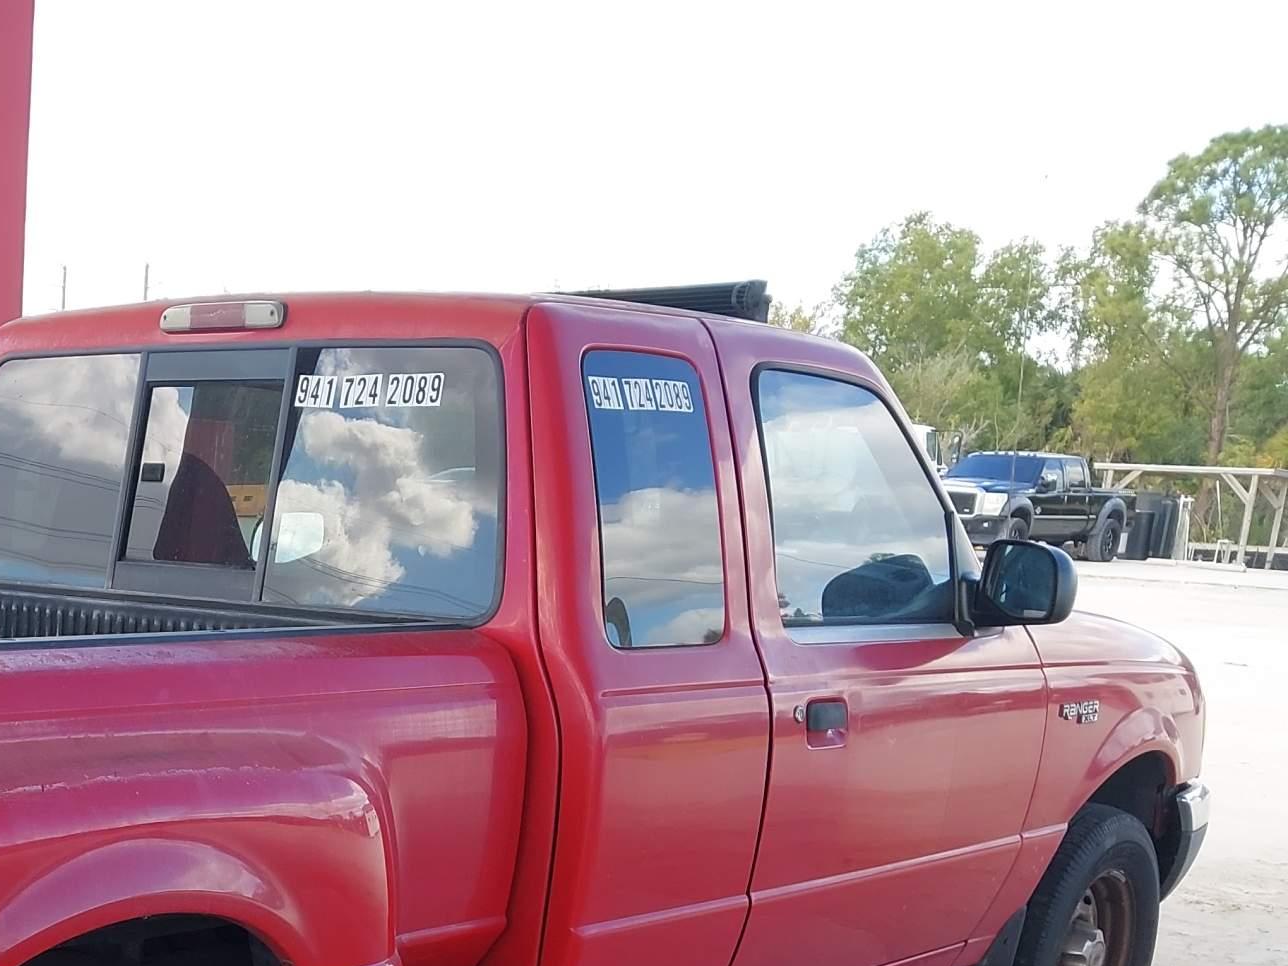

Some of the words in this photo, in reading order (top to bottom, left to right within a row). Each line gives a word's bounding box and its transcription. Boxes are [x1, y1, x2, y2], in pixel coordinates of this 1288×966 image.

[297, 376, 334, 407] 941
[343, 376, 379, 407] 724
[387, 374, 442, 406] 2089
[591, 379, 622, 408] 941
[624, 380, 653, 409] 724
[655, 382, 692, 410] 2089
